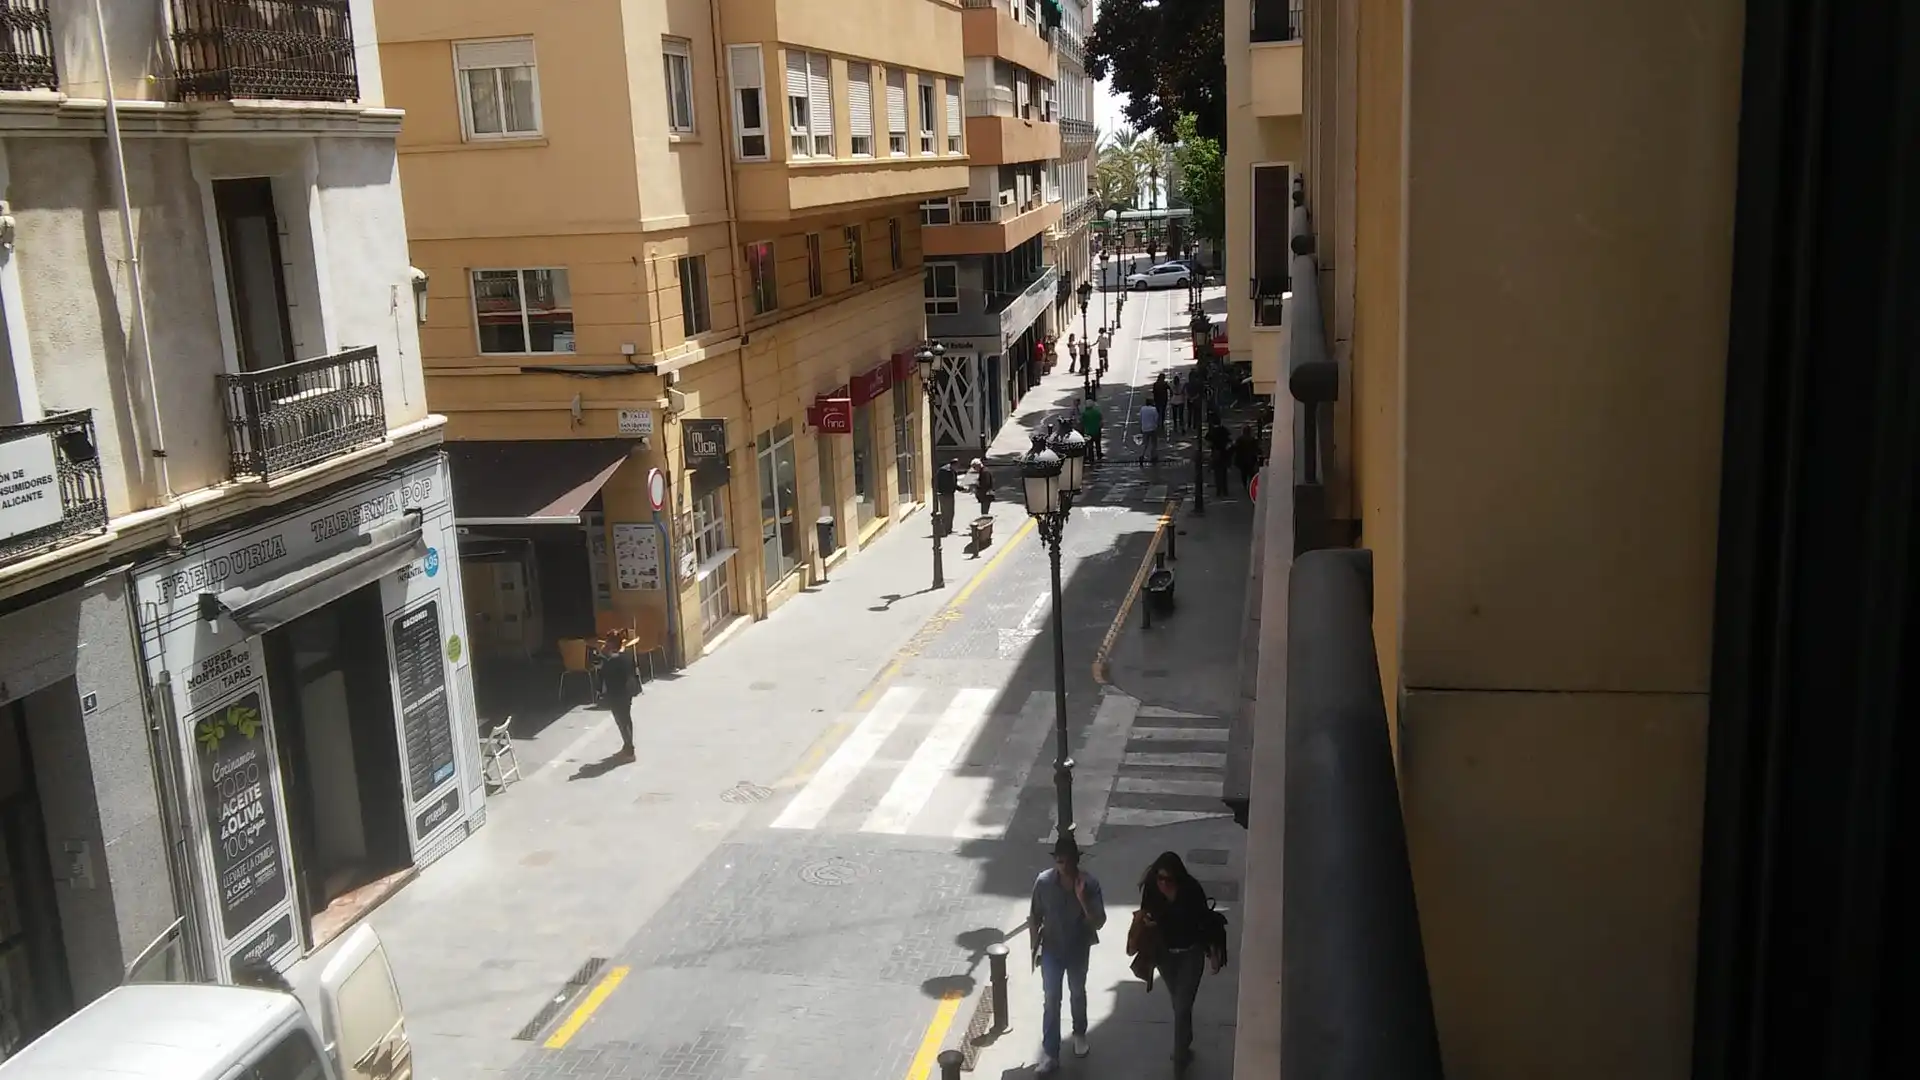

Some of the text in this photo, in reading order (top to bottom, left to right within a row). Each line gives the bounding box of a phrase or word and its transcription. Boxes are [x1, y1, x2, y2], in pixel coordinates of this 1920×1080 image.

[12, 469, 24, 479] DE
[2, 490, 44, 509] ALICANTE
[155, 478, 432, 605] FREIDURIA TABERNA POP
[187, 651, 250, 689] MONTADITOS
[202, 649, 232, 671] SUPER
[221, 665, 252, 689] TAPAS
[213, 763, 259, 804] TODO
[221, 782, 262, 821] ACEITE
[227, 800, 264, 834] OLIVA
[232, 875, 252, 895] CASA
